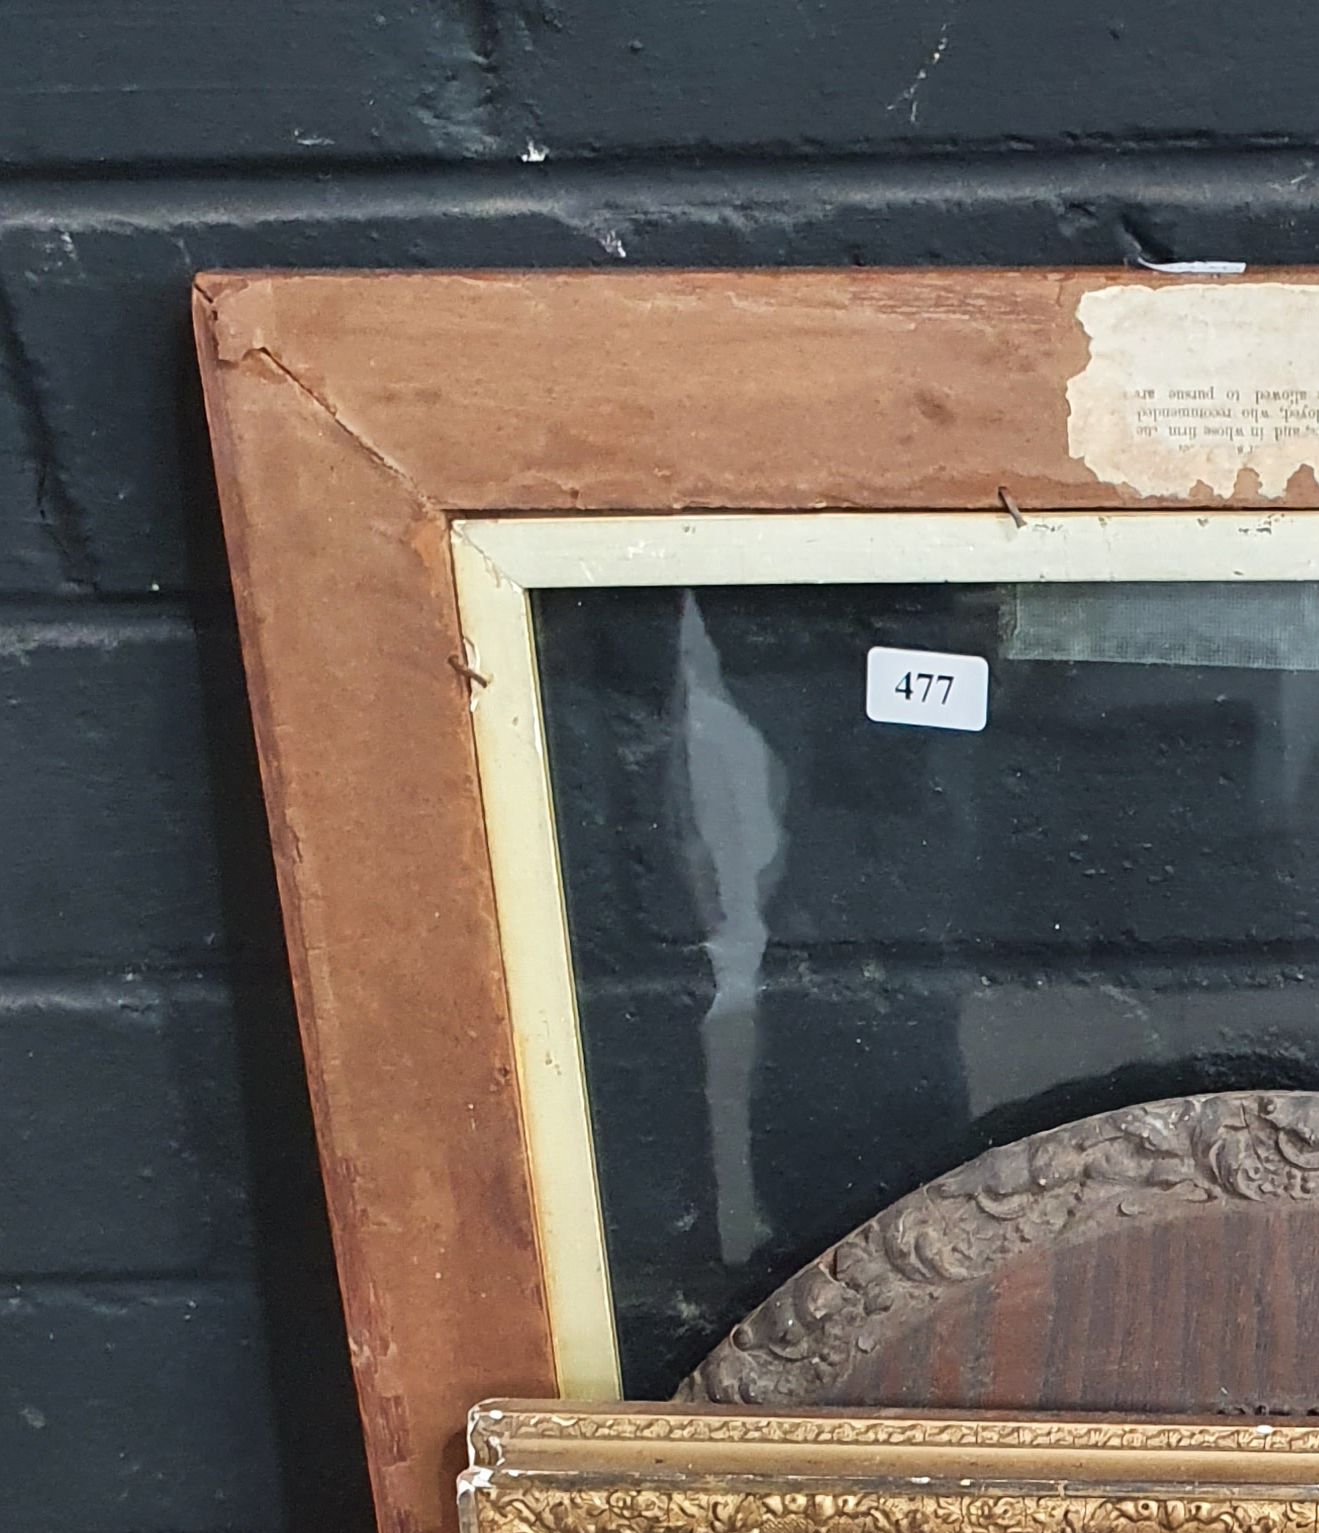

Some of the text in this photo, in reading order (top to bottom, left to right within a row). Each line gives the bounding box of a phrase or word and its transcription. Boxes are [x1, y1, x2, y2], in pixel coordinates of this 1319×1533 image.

[1168, 386, 1215, 401] pursue
[1226, 390, 1240, 404] to
[1255, 390, 1307, 406] allowed
[1137, 407, 1232, 422] recommended
[1241, 409, 1269, 423] who
[1169, 426, 1197, 440] firm
[1203, 426, 1244, 441] whose
[1251, 426, 1263, 441] in
[1274, 426, 1300, 442] and
[895, 671, 954, 705] 477
